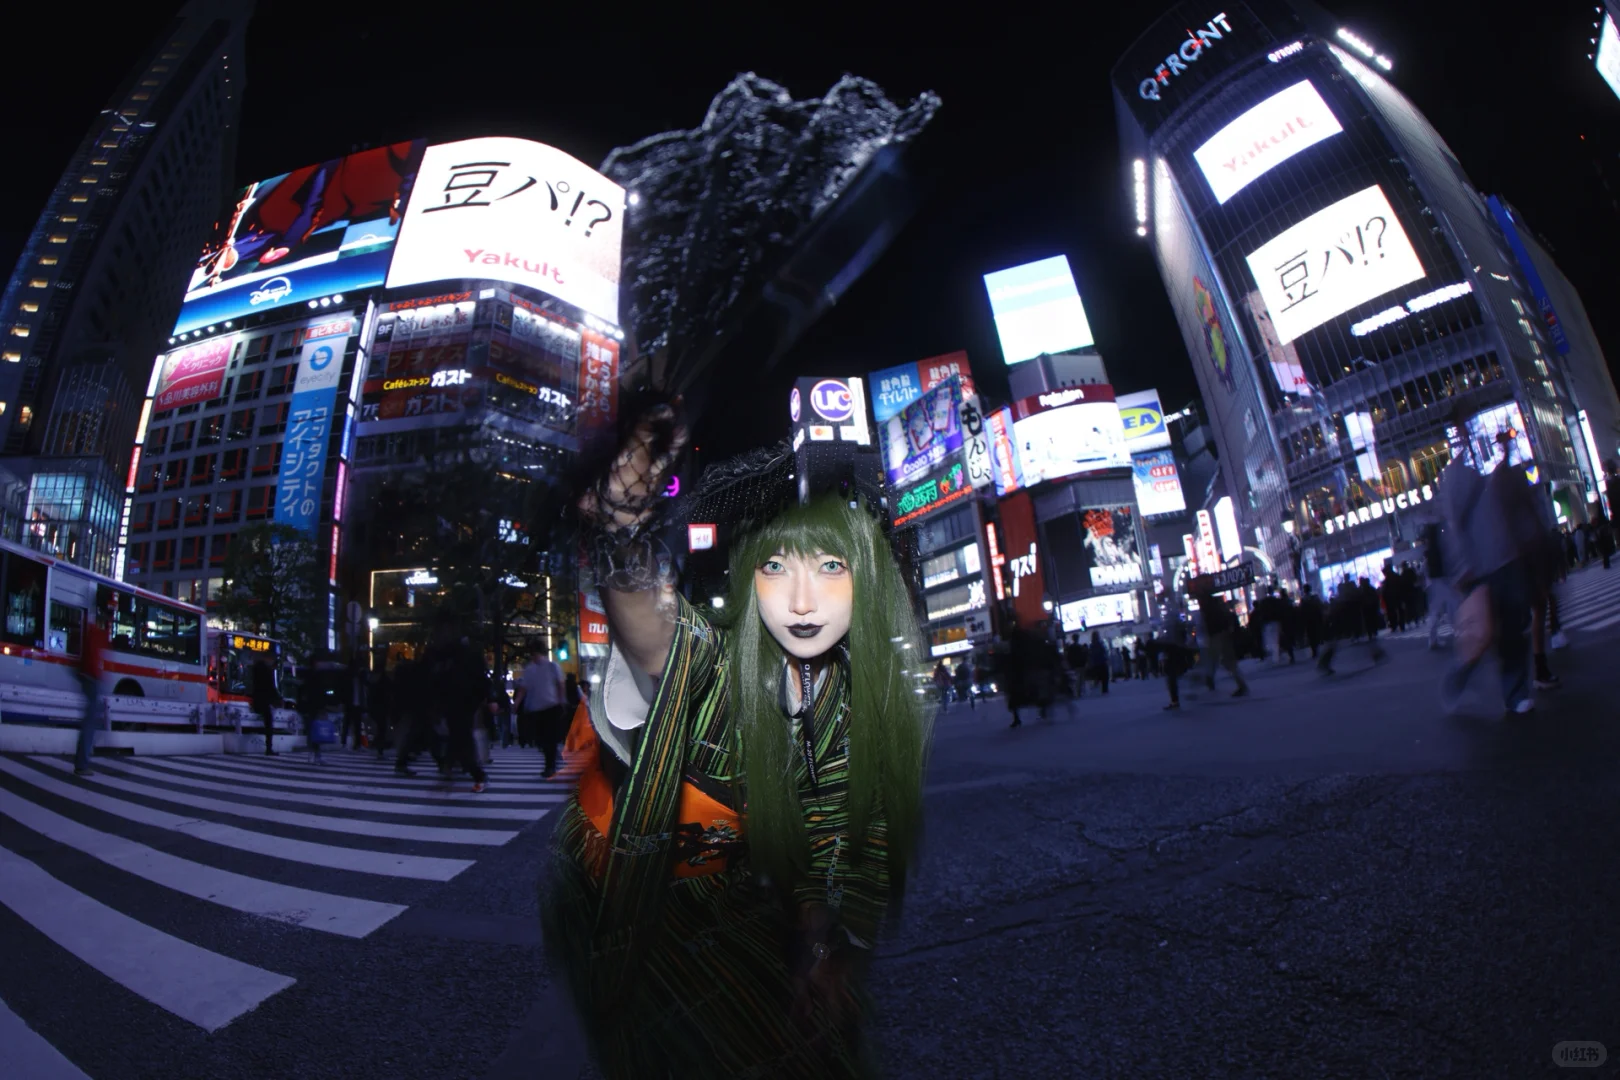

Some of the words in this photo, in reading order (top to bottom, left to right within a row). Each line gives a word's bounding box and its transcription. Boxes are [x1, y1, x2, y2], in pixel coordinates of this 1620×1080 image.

[1138, 12, 1232, 100] QFRONT
[1223, 115, 1315, 172] Yakult
[463, 248, 565, 285] Yakult
[377, 323, 393, 335] 9F
[431, 369, 473, 388] ガスト
[538, 386, 571, 408] ガスト
[961, 402, 992, 481] もんじゃ
[1123, 412, 1157, 431] EA
[280, 409, 312, 518] アイシティ
[300, 406, 328, 516] コンタクトの
[1323, 484, 1434, 535] STARBUCKS
